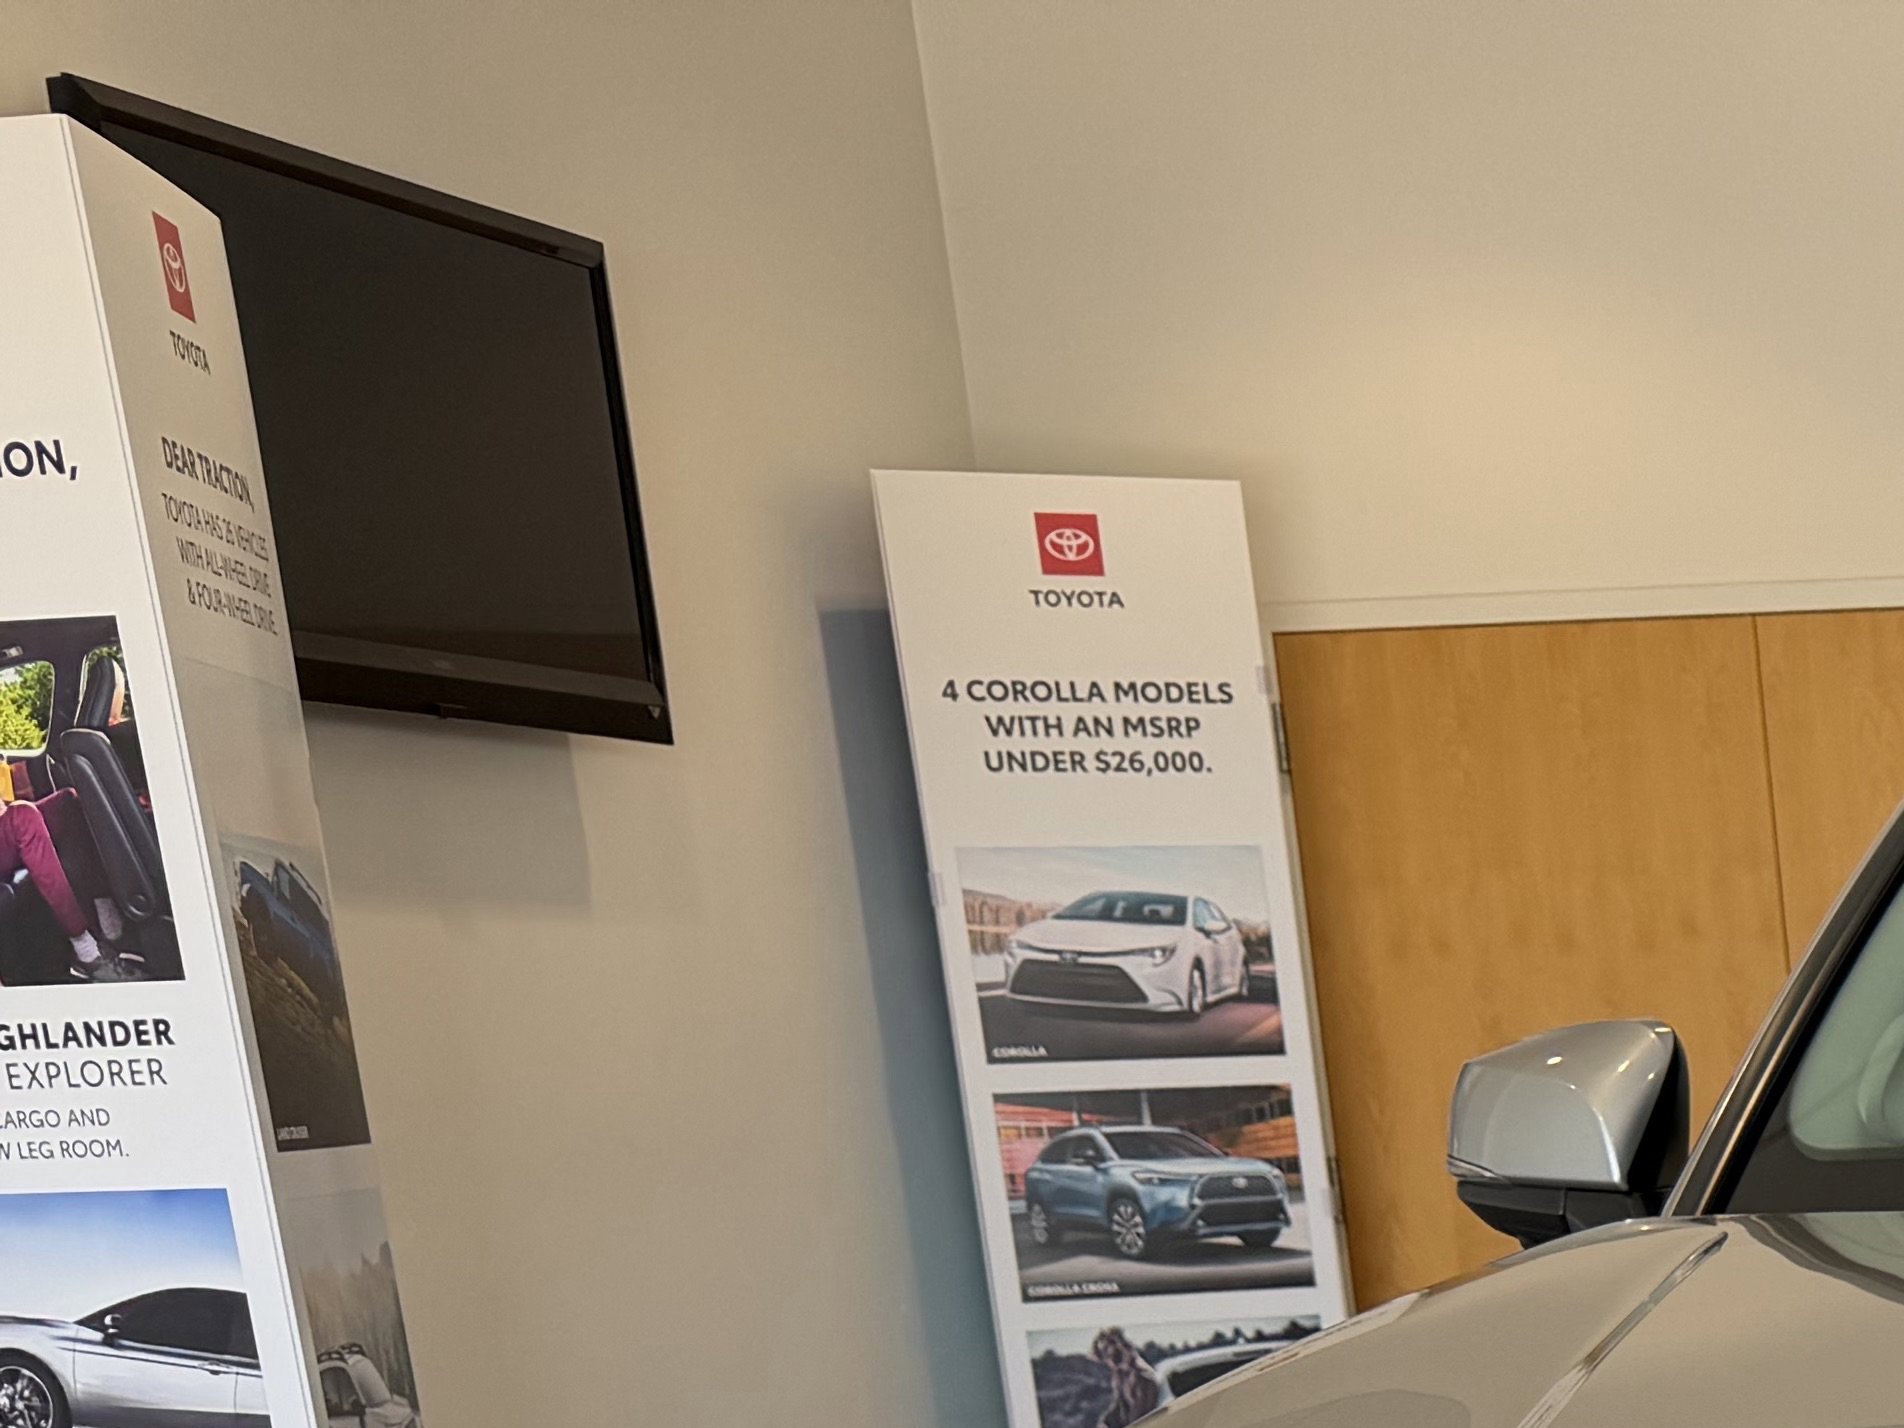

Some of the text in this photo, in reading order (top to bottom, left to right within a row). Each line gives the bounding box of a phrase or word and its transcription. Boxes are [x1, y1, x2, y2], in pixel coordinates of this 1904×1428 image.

[169, 329, 211, 375] TOYOTA
[0, 438, 78, 481] ON,
[161, 436, 255, 513] DEAR TRACTION,
[161, 492, 204, 533] TOYOTA
[176, 536, 205, 571] WITH
[1028, 589, 1125, 608] TOYOTA
[942, 679, 1235, 705] 4 COROLLA MODELS
[984, 715, 1202, 739] WITH AN MSRP
[984, 750, 1213, 777] UNDER $26,000.
[0, 1018, 176, 1051] GHLANDER
[5, 1058, 168, 1090] EXPLORER
[0, 1108, 111, 1129] ARGO AND
[17, 1141, 55, 1160] LEG
[59, 1139, 130, 1159] ROOM.
